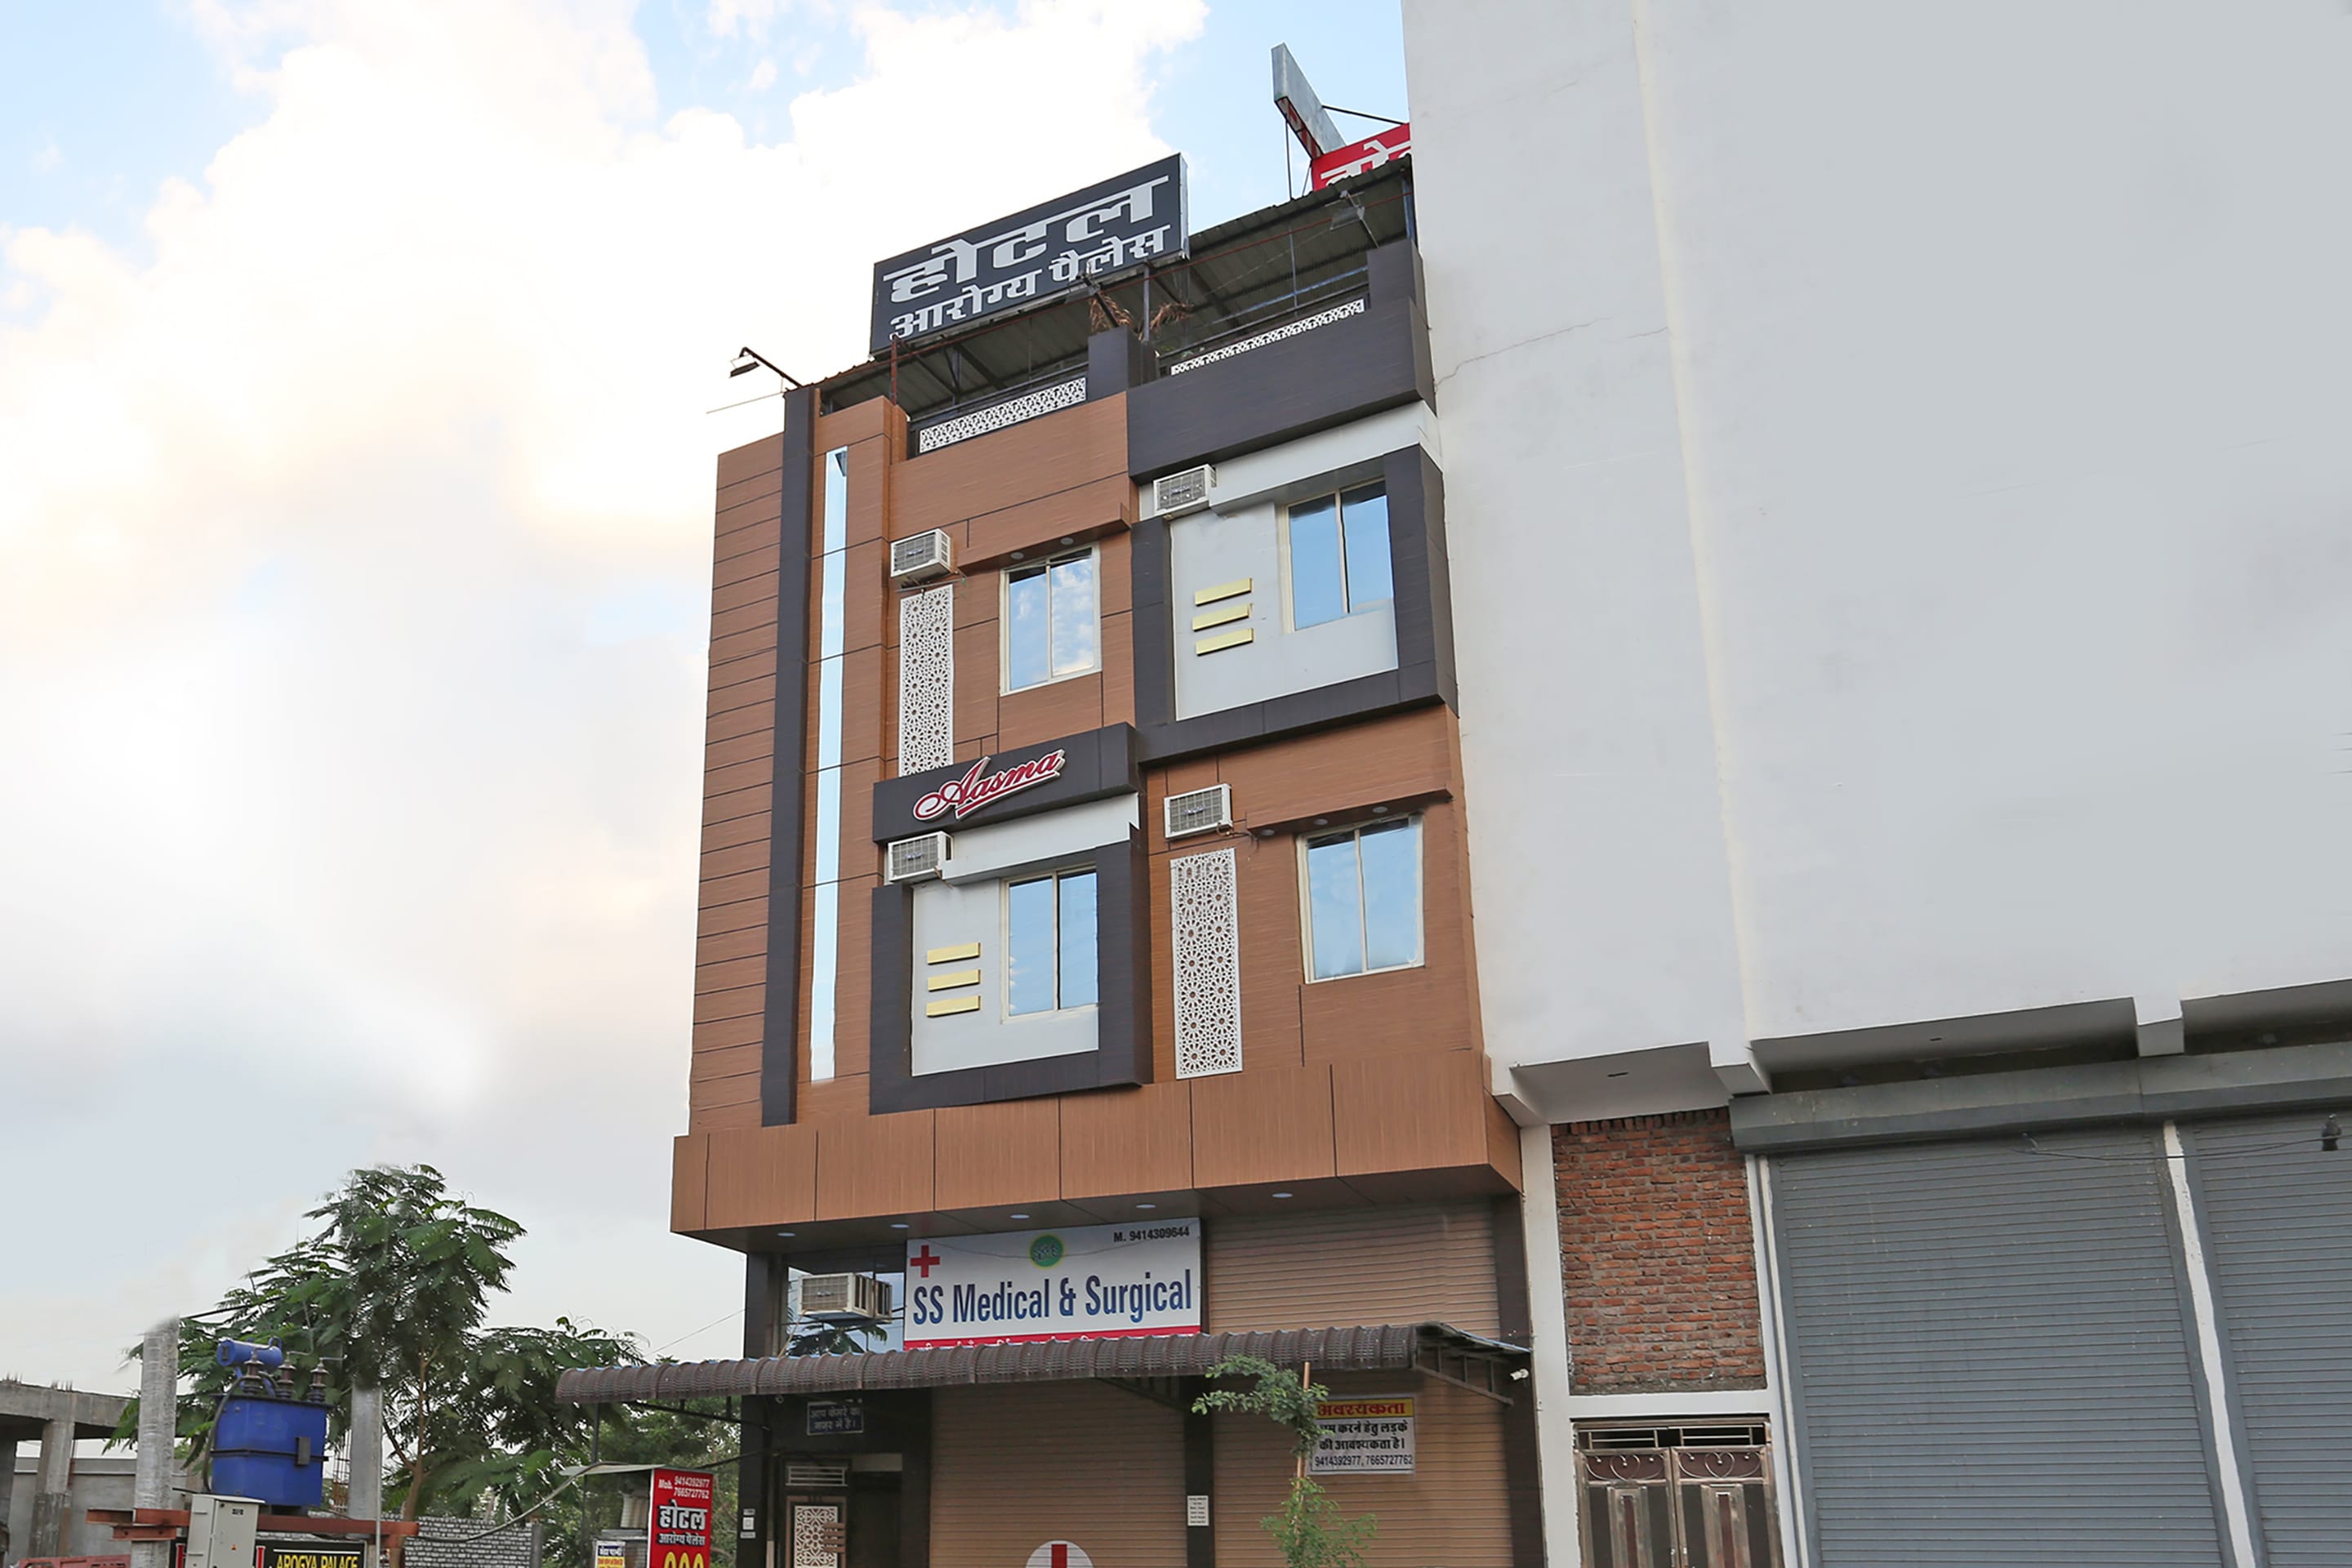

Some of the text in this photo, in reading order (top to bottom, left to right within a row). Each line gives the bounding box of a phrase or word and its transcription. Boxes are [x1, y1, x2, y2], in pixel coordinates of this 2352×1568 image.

[883, 176, 1169, 302] होटल
[889, 269, 1043, 340] आरोग्य
[913, 749, 1065, 820] Aasma
[1113, 1232, 1127, 1242] M.
[913, 1269, 1192, 1325] SS Medical & Surgical
[1319, 1437, 1333, 1450] की
[658, 1499, 708, 1530] होटल
[276, 1554, 358, 1568] AROGYA PALACE
